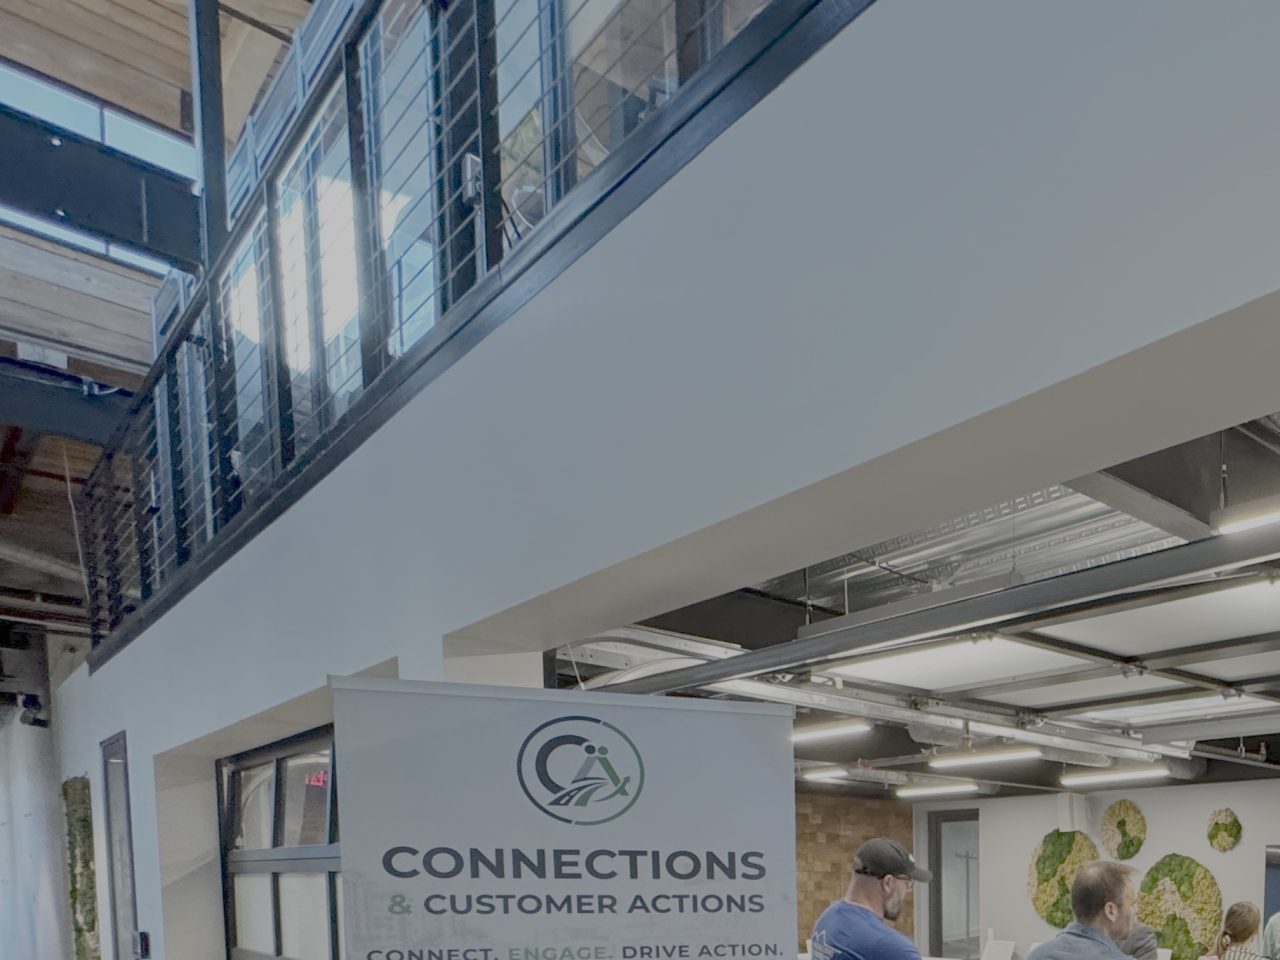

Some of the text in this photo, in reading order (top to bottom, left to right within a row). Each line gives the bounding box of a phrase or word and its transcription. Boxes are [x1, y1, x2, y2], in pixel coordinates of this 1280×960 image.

[382, 846, 767, 880] CONNECTIONS
[387, 894, 765, 915] & CUSTOMER ACTIONS
[622, 945, 690, 959] DRIVE
[698, 943, 784, 958] ACTION.
